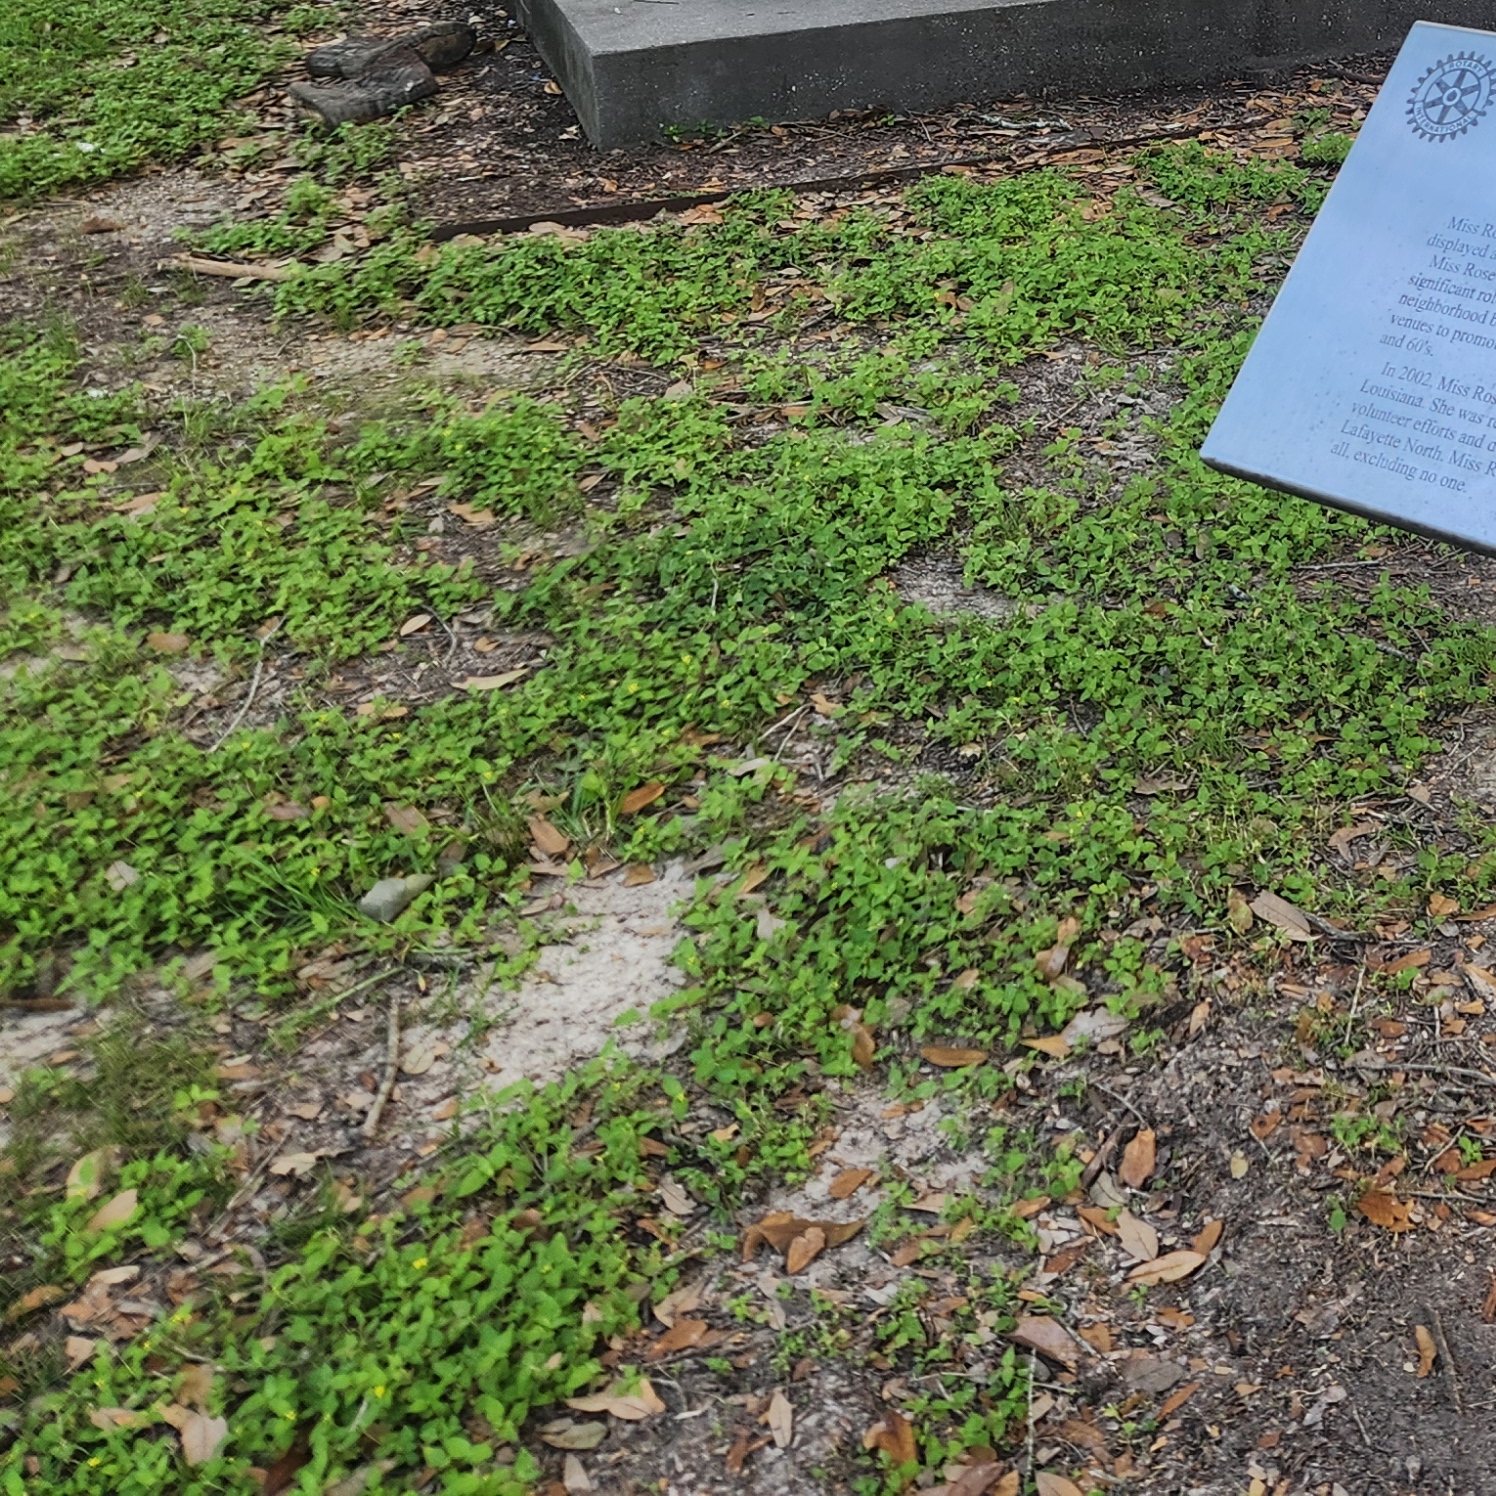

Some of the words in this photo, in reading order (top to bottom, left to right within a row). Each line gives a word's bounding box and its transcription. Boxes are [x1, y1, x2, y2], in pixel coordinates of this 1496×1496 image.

[1448, 60, 1483, 74] ROTARY
[1415, 106, 1474, 133] INTERNATIONAL
[1446, 215, 1480, 235] Miss
[1425, 232, 1490, 258] displayed
[1428, 253, 1461, 274] Miss
[1407, 271, 1477, 299] significant
[1397, 293, 1490, 325] neighborhood
[1390, 313, 1435, 334] venues
[1435, 323, 1450, 338] to
[1379, 333, 1407, 348] and
[1405, 337, 1434, 357] 60's.
[1380, 361, 1396, 378] In
[1436, 375, 1471, 397] Miss
[1428, 397, 1455, 417] She
[1458, 408, 1485, 425] was
[1351, 402, 1413, 428] volunteer
[1412, 417, 1457, 441] efforts
[1457, 432, 1487, 449] and
[1340, 418, 1402, 449] Lafayette
[1402, 436, 1443, 462] North.
[1448, 449, 1483, 473] Miss
[1329, 441, 1350, 460] all,
[1353, 450, 1418, 481] excluding
[1418, 469, 1438, 484] no
[1439, 475, 1467, 493] one.
